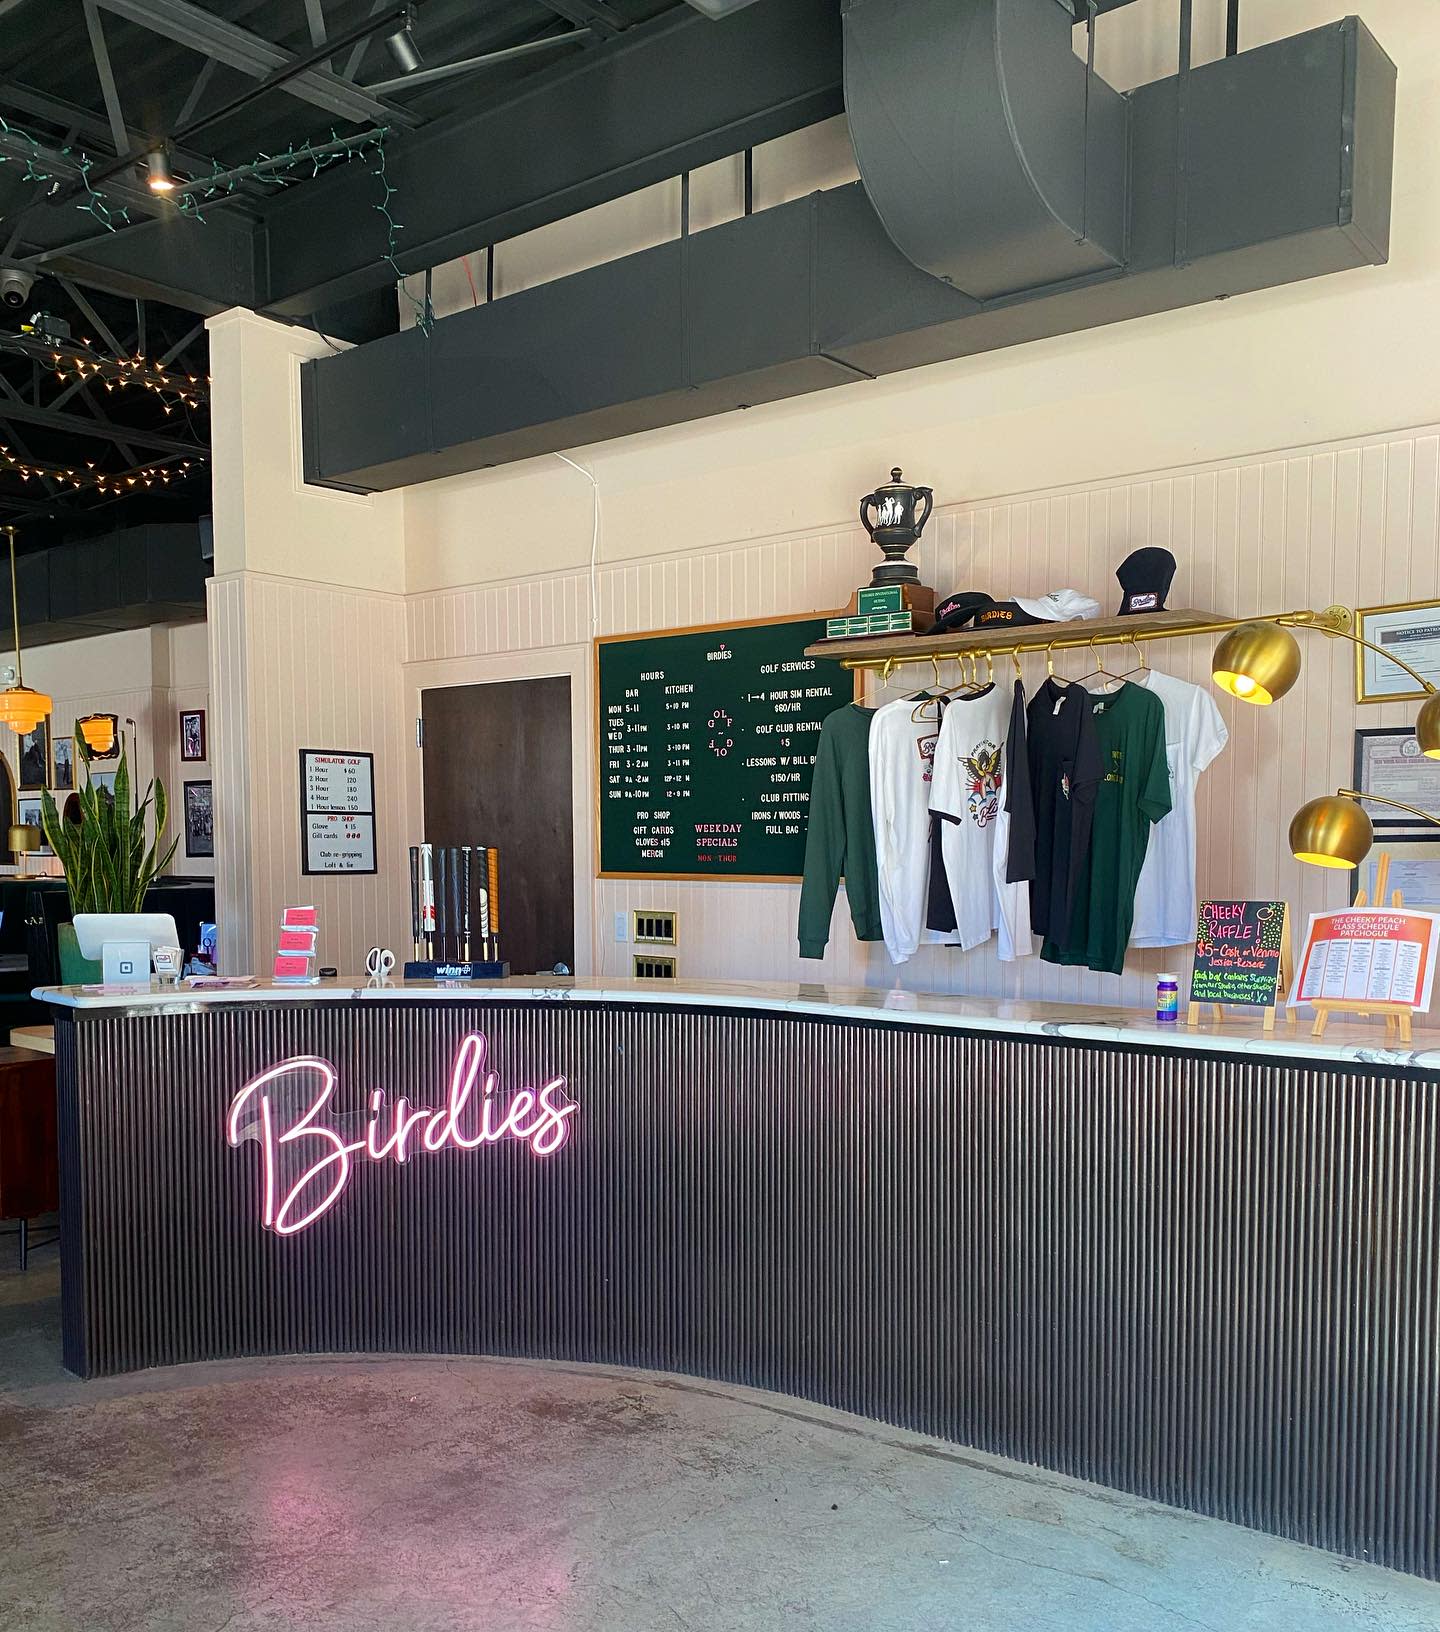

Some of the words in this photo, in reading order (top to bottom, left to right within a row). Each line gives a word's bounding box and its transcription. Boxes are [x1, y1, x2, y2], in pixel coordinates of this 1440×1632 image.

[707, 650, 732, 661] BIRDIES
[760, 663, 779, 674] GOLF
[782, 660, 816, 672] SERVICES
[641, 671, 665, 681] HOURS
[626, 689, 639, 698] BAR
[665, 684, 694, 695] KITCHEN
[770, 691, 788, 700] HOUR
[790, 690, 802, 699] SIM
[806, 687, 832, 698] RENTAL
[608, 705, 622, 714] MON
[775, 703, 801, 712] $60/HR
[608, 718, 624, 727] TUES
[756, 725, 774, 734] GOLF
[776, 724, 794, 733] CLUB
[796, 722, 822, 731] RENTAL
[608, 732, 622, 740] WED
[781, 738, 790, 747] $5
[608, 745, 624, 754] THUR
[746, 758, 776, 767] LESSONS
[780, 757, 790, 766] W/
[793, 756, 808, 765] BILL
[771, 773, 800, 782] $150/HR
[761, 793, 780, 802] CLUB
[783, 793, 809, 802] FITTING
[637, 812, 648, 820] PRO
[654, 811, 670, 819] SHOP
[752, 812, 771, 820] IRONS
[779, 811, 800, 820] WOODS
[633, 826, 647, 835] GIFT
[652, 826, 674, 834] CARDS
[766, 826, 782, 834] FULL
[786, 826, 799, 834] BAG
[696, 838, 738, 846] SPECIALS
[642, 850, 664, 858] MERCH
[1203, 902, 1246, 924] CHEEKY
[1209, 920, 1252, 938] RAFFLE
[437, 964, 461, 975] winn
[230, 1033, 577, 1234] Birdies
